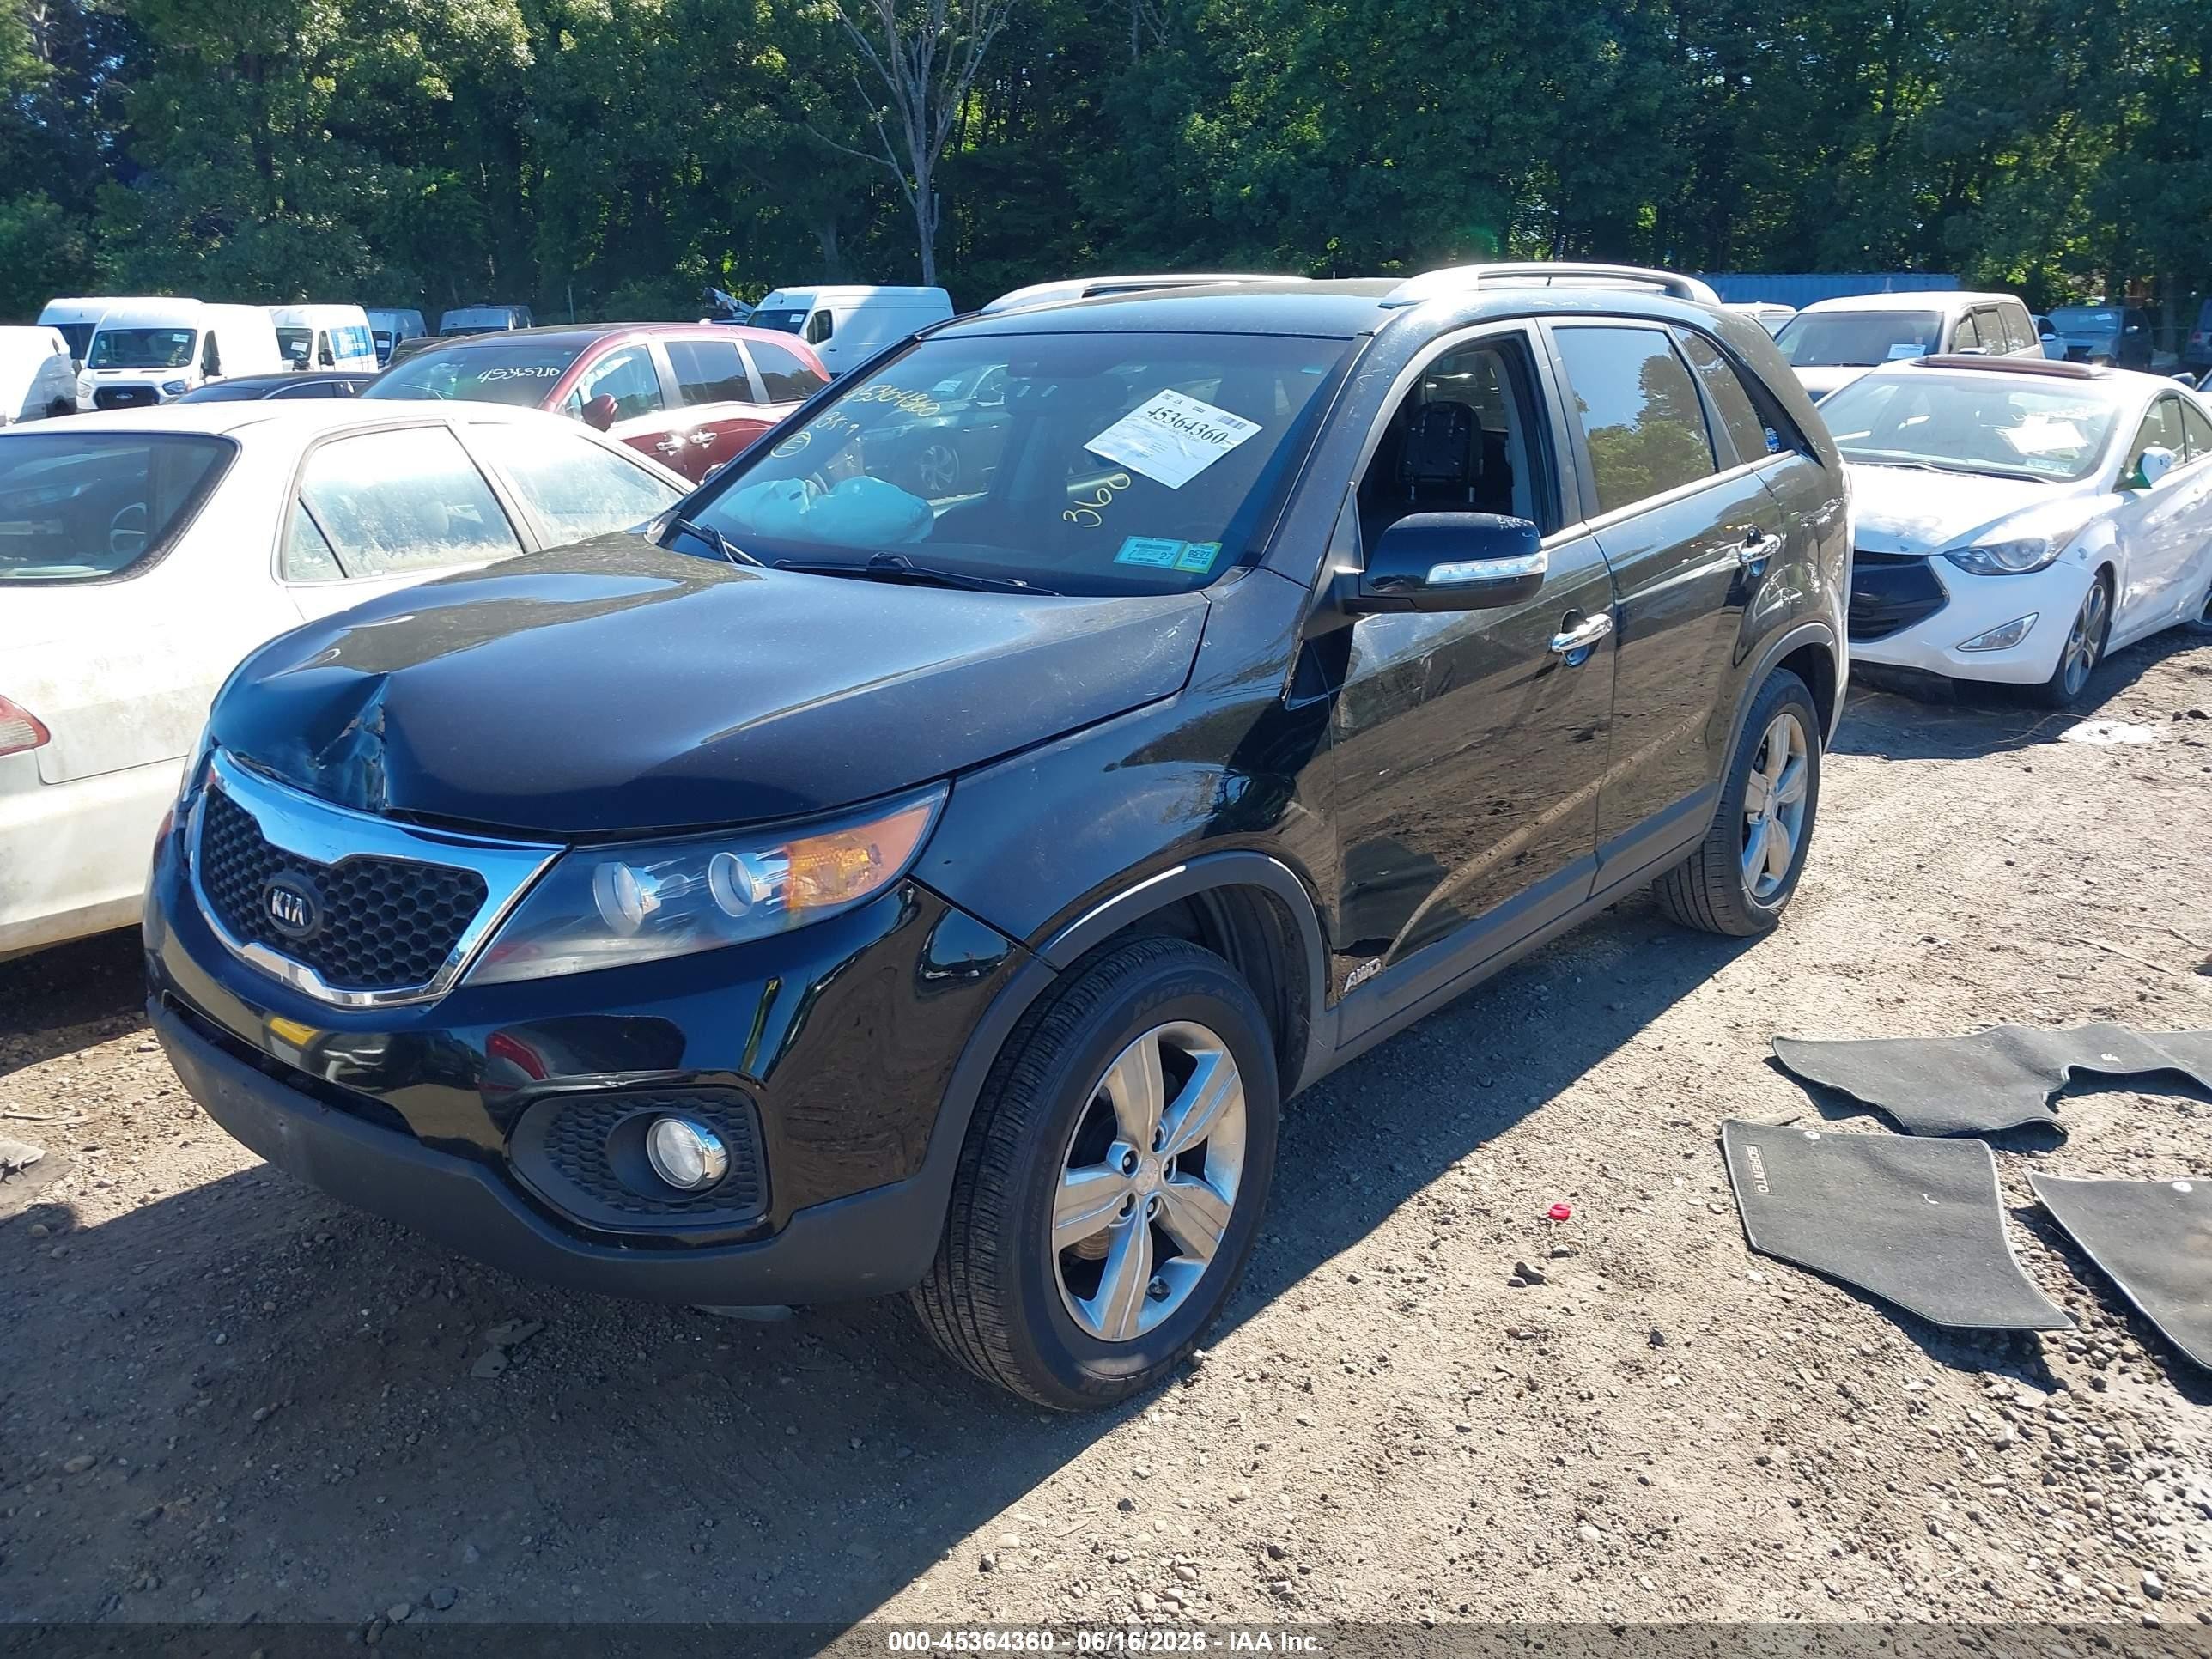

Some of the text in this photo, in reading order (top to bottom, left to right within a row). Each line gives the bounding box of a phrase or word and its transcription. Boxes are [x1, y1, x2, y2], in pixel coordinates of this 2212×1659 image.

[1147, 405, 1229, 445] 45364360
[1062, 472, 1132, 528] 360
[271, 888, 305, 926] KIA
[1745, 1146, 1770, 1193] SORENTO
